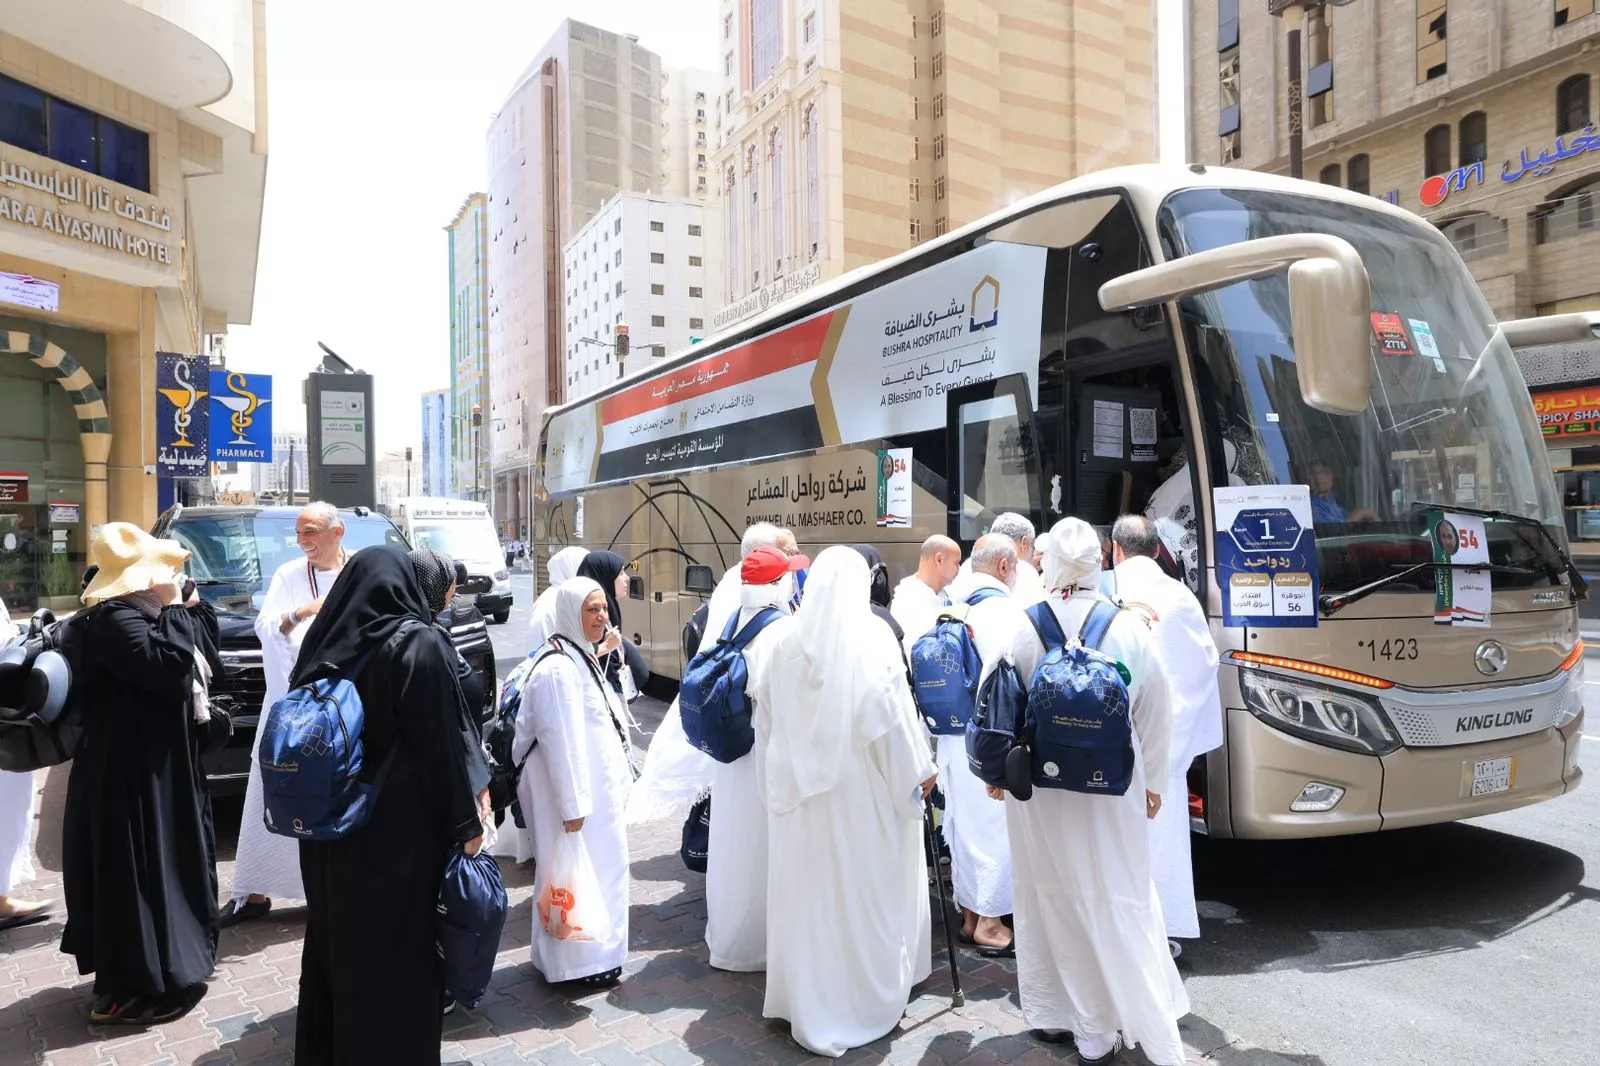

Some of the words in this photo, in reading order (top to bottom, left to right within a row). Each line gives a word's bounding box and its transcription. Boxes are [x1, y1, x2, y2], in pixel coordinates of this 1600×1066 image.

[86, 181, 110, 212] تارا
[115, 195, 171, 232] فندق
[42, 210, 123, 250] ALYASMIN
[127, 234, 171, 264] HOTEL
[923, 298, 964, 328] بشرى
[884, 313, 922, 338] الضيافة
[882, 340, 911, 357] BUSHRA
[913, 325, 963, 351] HOSPITALITY
[916, 359, 945, 380] لكل
[947, 346, 996, 374] بشرى
[881, 367, 915, 386] ضيف
[880, 395, 887, 406] A
[924, 385, 934, 397] To
[1536, 412, 1570, 424] SPICY
[158, 447, 207, 470] صيدلية
[216, 448, 265, 458] PHARMACY
[894, 458, 906, 473] 54
[746, 475, 789, 506] المشاعر
[791, 473, 825, 502] رواحل
[829, 466, 866, 498] شركة
[785, 513, 797, 527] AL
[799, 510, 845, 527] MASHAER
[847, 509, 866, 525] CO.
[1260, 518, 1275, 540] 1
[1459, 528, 1479, 549] 54
[1244, 555, 1278, 569] واحد
[1279, 556, 1290, 568] رد
[1288, 603, 1301, 612] 56
[1456, 714, 1494, 732] KING
[1495, 709, 1533, 728] LONG
